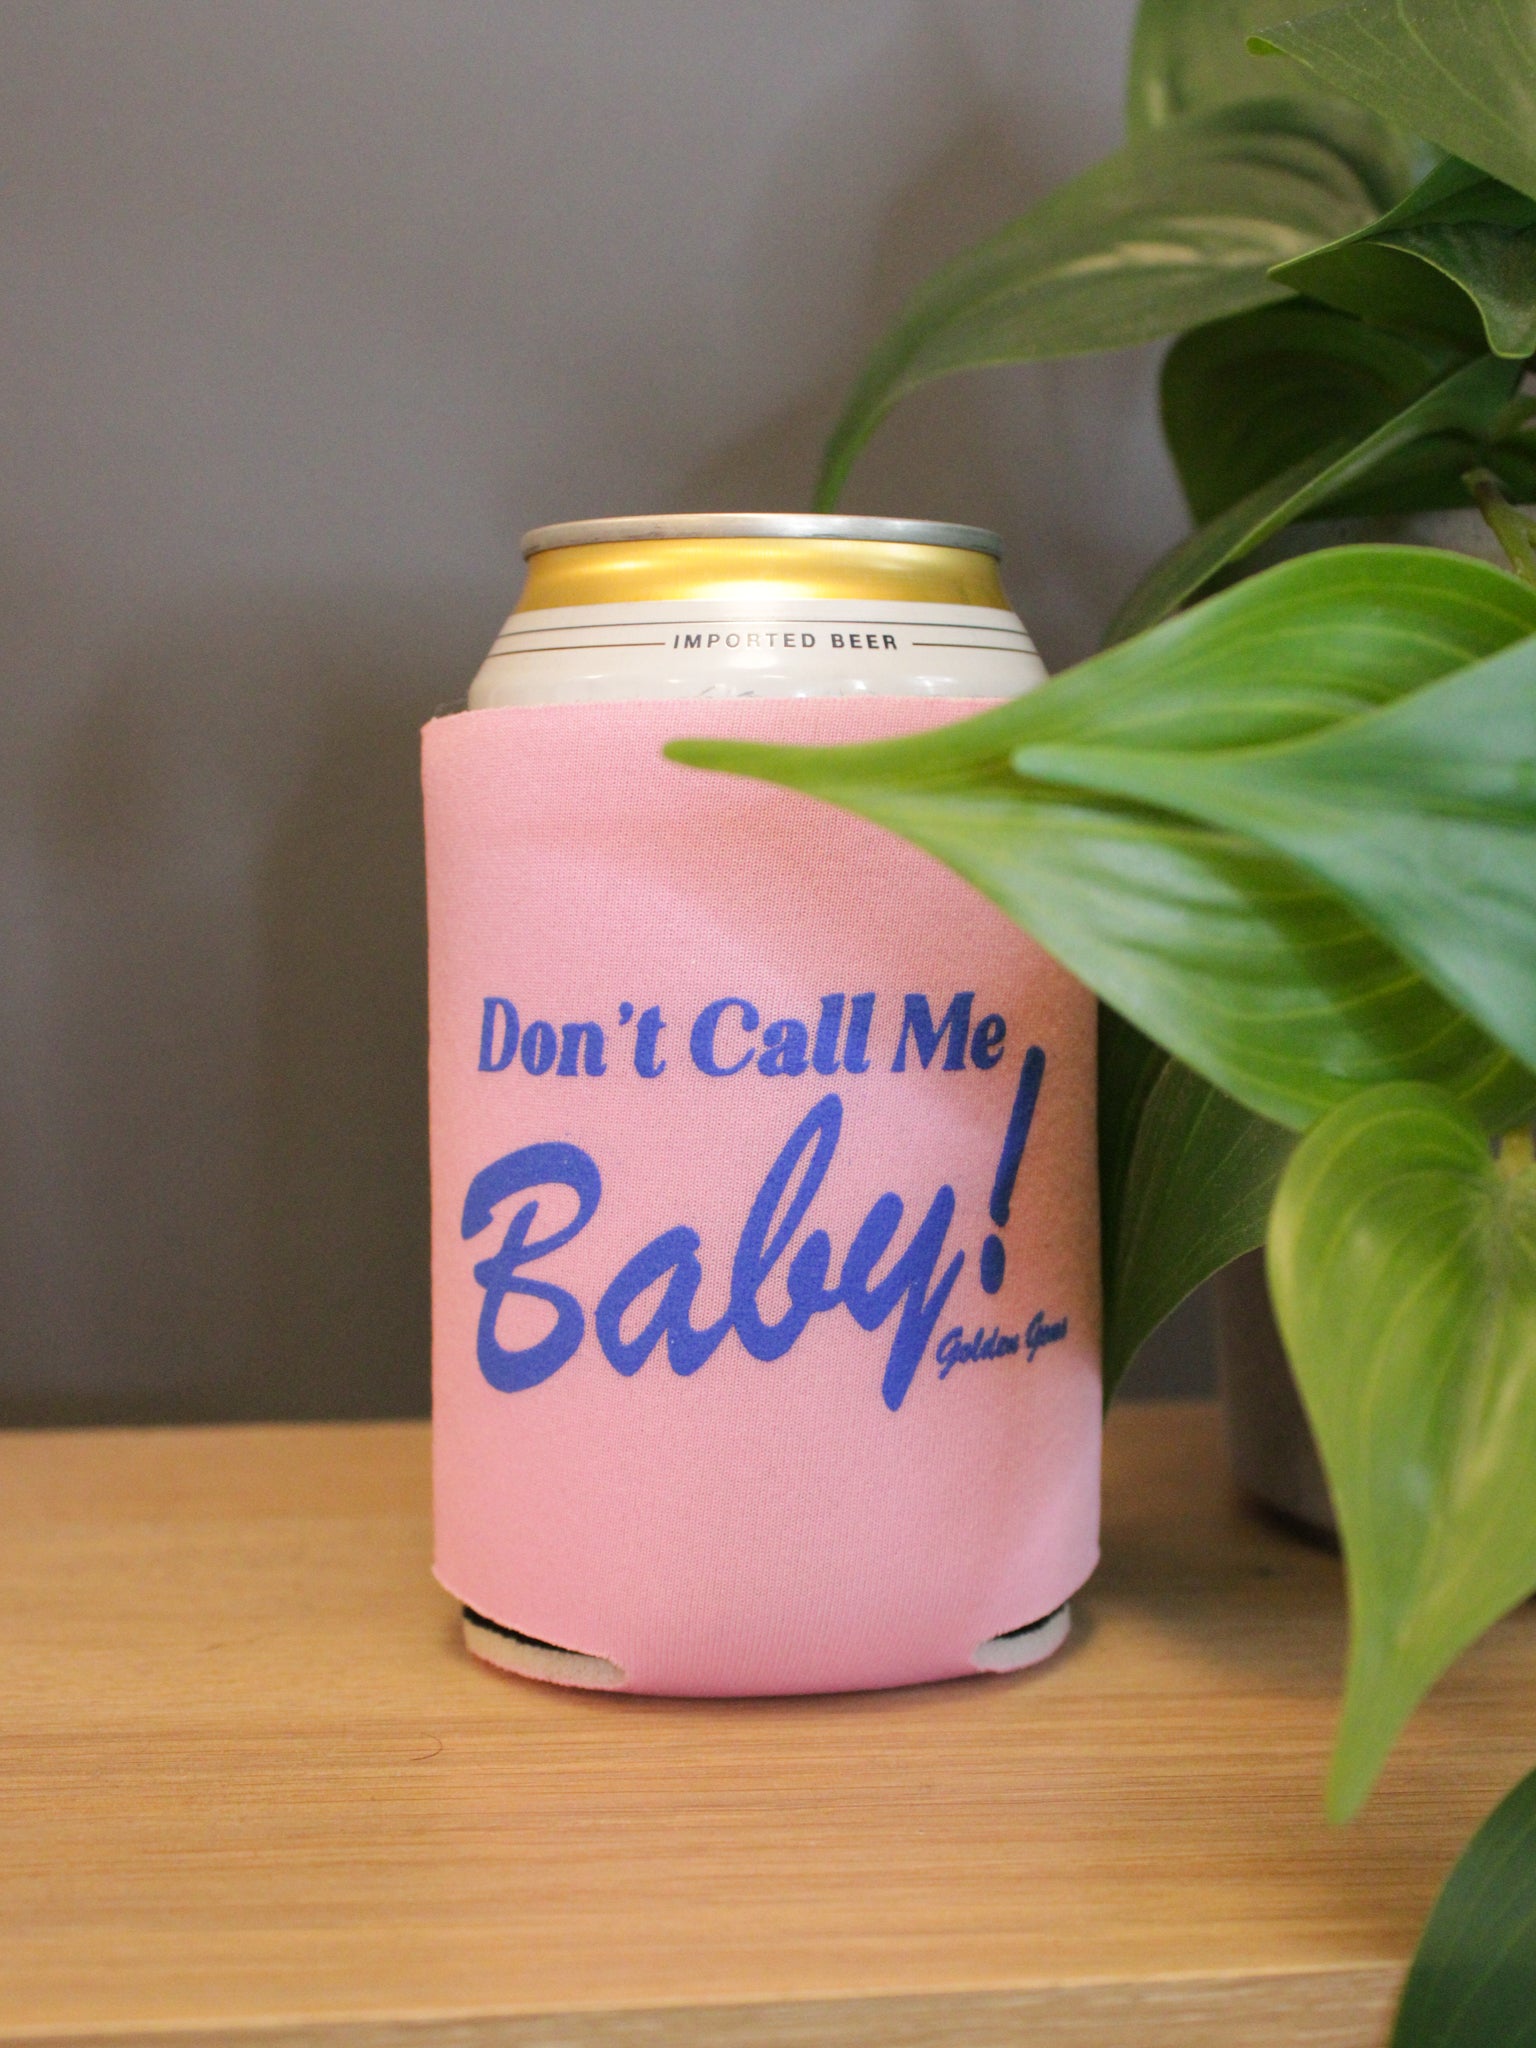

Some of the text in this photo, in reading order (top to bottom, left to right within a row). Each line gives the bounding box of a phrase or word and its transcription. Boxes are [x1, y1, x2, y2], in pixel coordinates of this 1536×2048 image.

[673, 633, 898, 650] IMPORTED BEER
[478, 991, 1006, 1079] Don't Call Me
[461, 1046, 1045, 1412] Baby!
